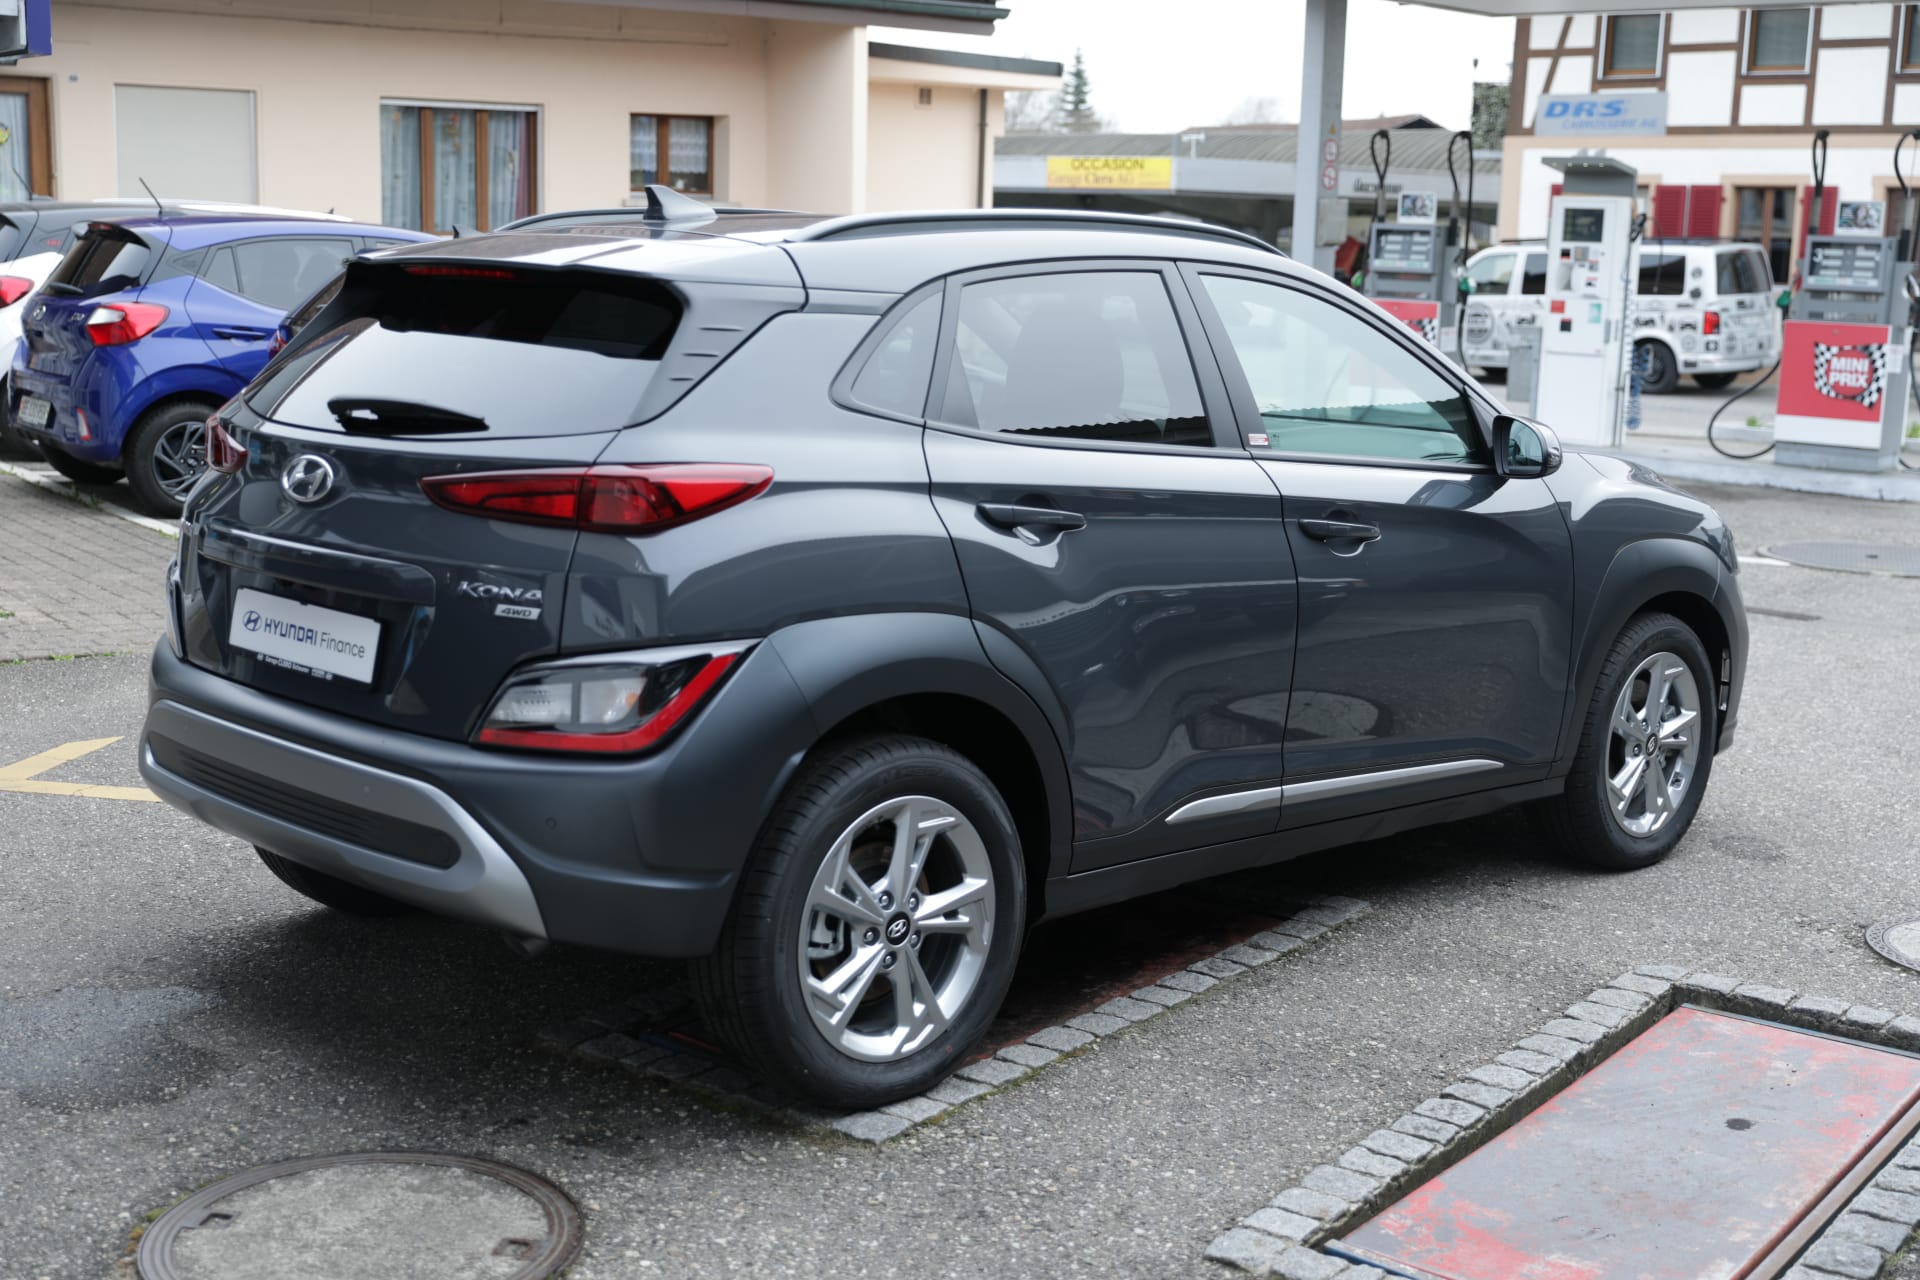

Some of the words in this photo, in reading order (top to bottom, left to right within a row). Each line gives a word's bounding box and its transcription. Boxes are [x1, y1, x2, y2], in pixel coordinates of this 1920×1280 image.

[1544, 99, 1625, 118] DRS
[1070, 158, 1145, 171] OCCASION
[1830, 357, 1870, 373] MINI
[1828, 371, 1868, 388] PRIX
[457, 581, 543, 602] KONA
[500, 607, 532, 617] 4WD
[264, 617, 318, 645] HYUNDAI
[320, 632, 366, 658] Finance
